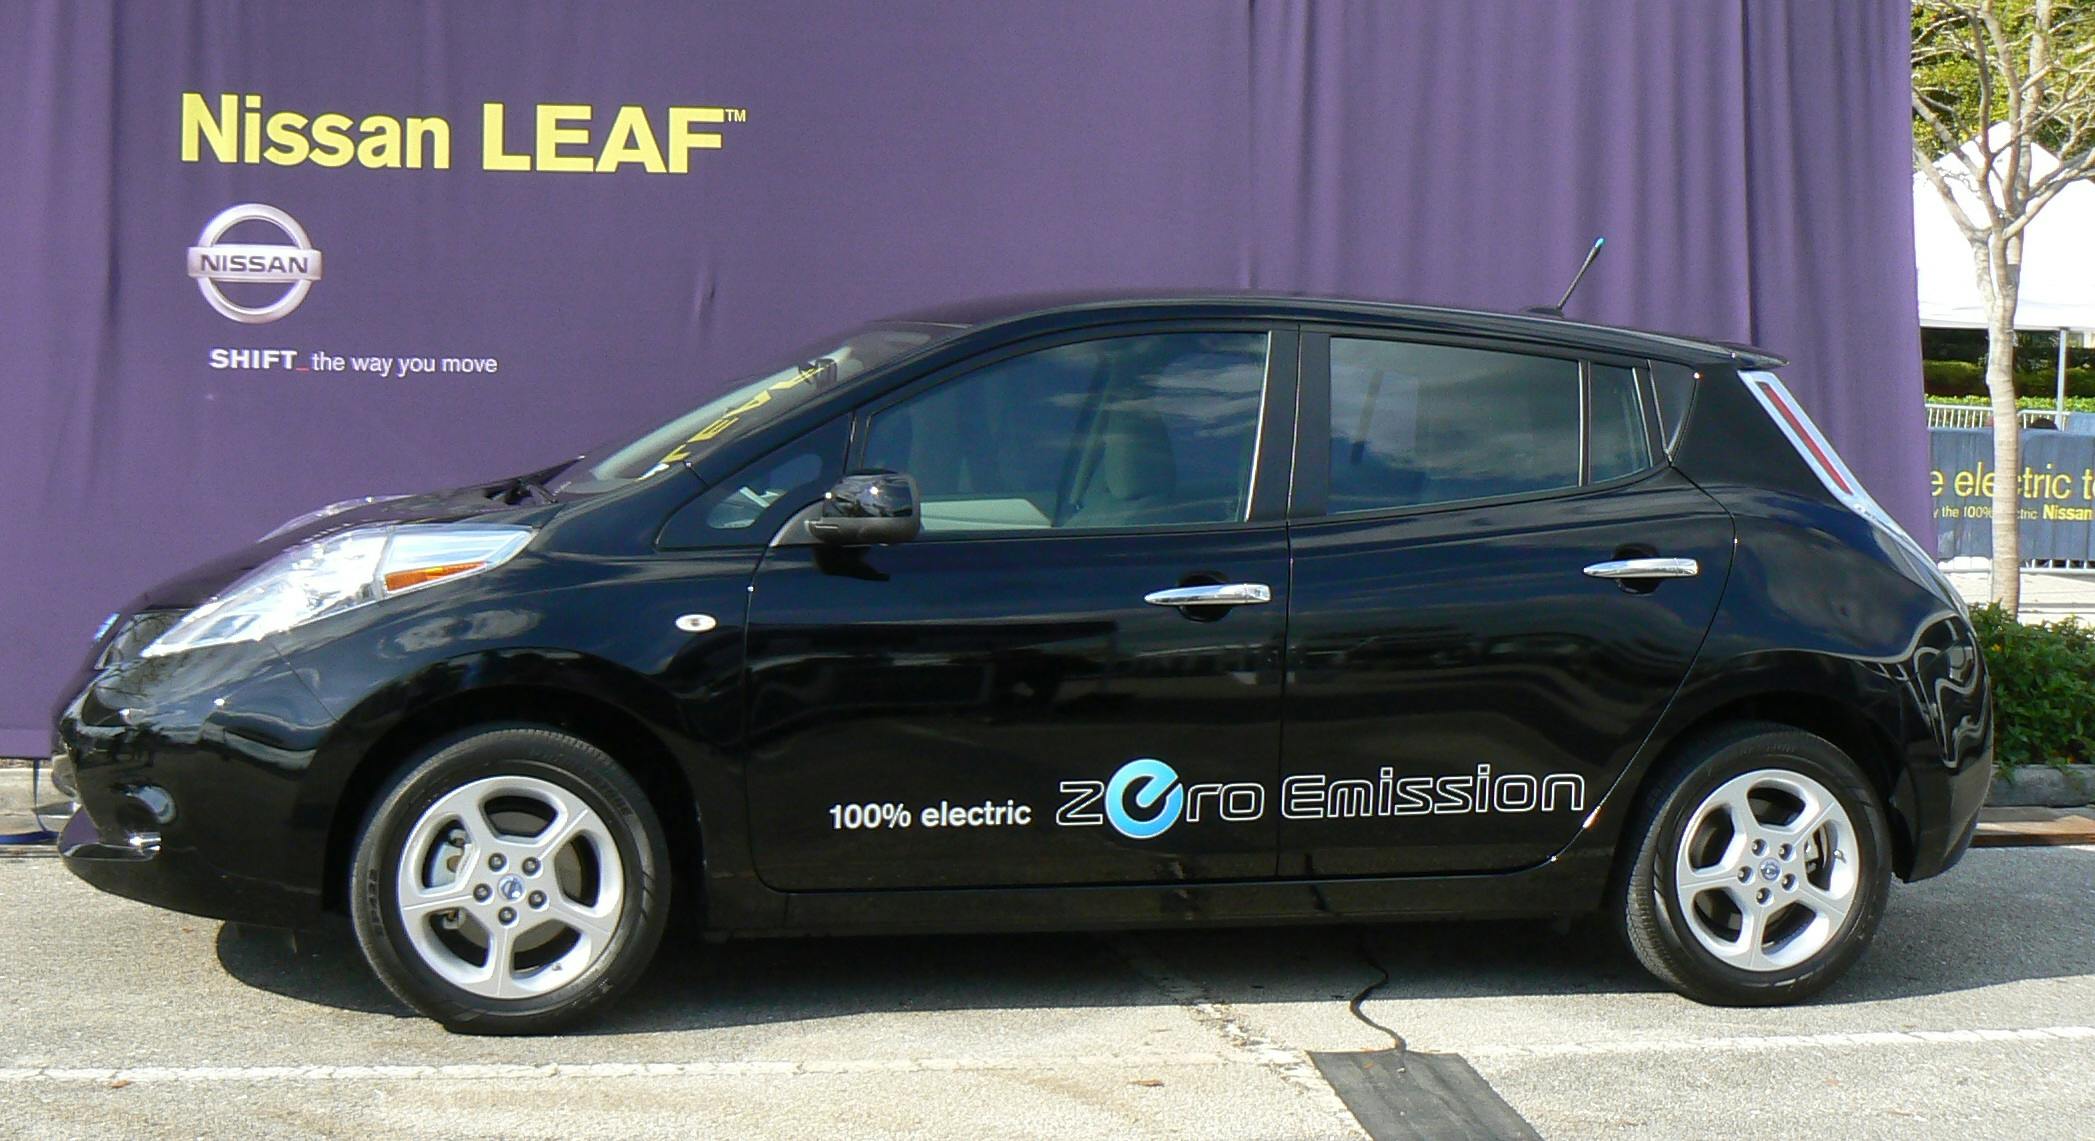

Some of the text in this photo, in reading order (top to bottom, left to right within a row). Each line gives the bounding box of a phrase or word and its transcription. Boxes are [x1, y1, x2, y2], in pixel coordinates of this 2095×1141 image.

[181, 92, 451, 170] Nissan
[200, 253, 309, 274] NISSAN
[312, 351, 346, 372] the
[351, 355, 393, 377] way
[397, 356, 436, 378] you
[441, 356, 499, 374] move
[1954, 461, 2072, 500] eletric
[1942, 505, 1960, 518] the
[2043, 503, 2093, 521] Nissan
[1281, 763, 1586, 820] Emission
[829, 799, 1032, 830] 100% electric
